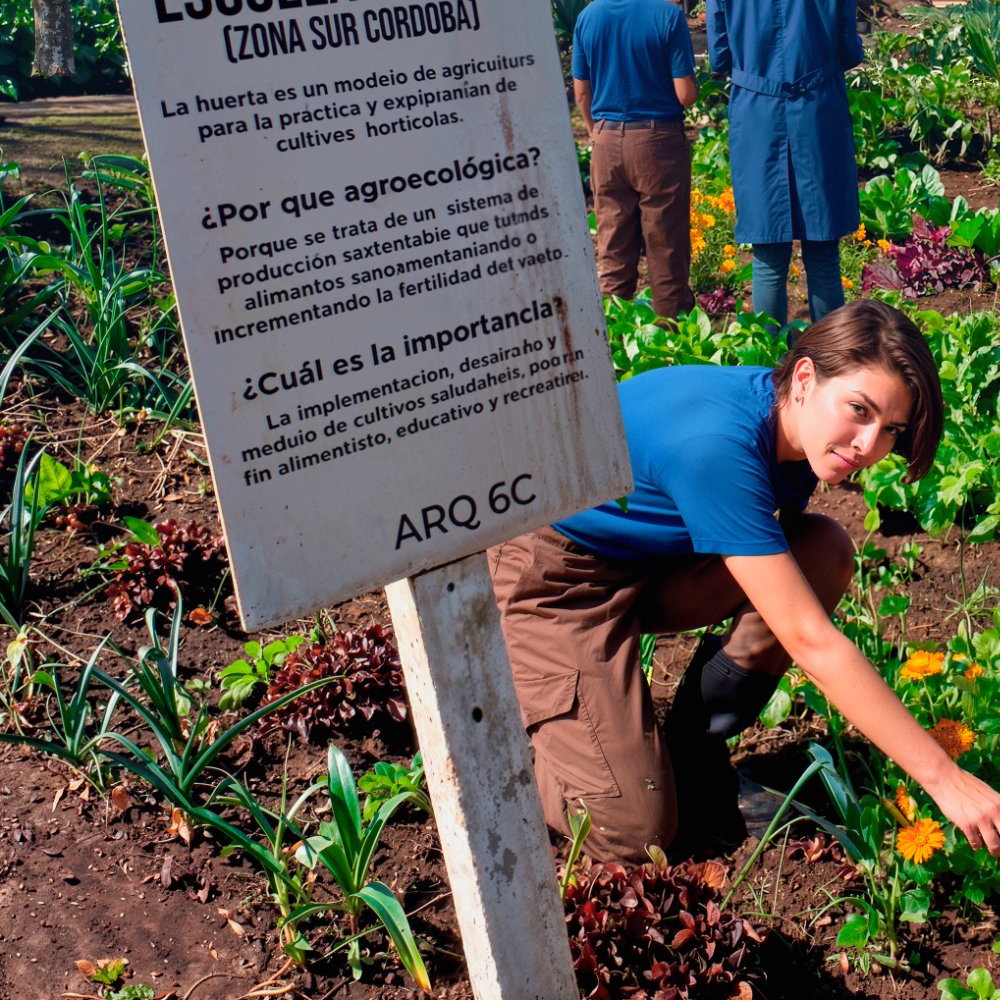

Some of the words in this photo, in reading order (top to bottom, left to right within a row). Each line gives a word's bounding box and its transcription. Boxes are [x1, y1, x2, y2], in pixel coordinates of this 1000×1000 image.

[222, 18, 307, 64] (ZONA
[308, 12, 360, 50] SUR
[160, 100, 190, 118] La
[195, 89, 268, 112] huerta
[274, 86, 297, 101] es
[303, 82, 329, 98] un
[413, 65, 437, 82] de
[197, 119, 248, 143] para
[254, 113, 273, 130] la
[366, 100, 378, 116] y
[495, 77, 518, 93] de
[276, 128, 356, 153] cultives
[365, 111, 464, 138] horticolas.
[201, 200, 271, 230] ¿Por
[280, 189, 335, 218] que
[344, 147, 541, 203] agroecológica?
[217, 253, 337, 294] producción
[456, 219, 489, 238] que
[219, 237, 298, 264] Porque
[304, 231, 326, 246] se
[332, 219, 378, 240] trata
[384, 212, 408, 229] de
[413, 207, 436, 223] un
[447, 192, 513, 216] sistema
[517, 184, 539, 201] de
[244, 276, 346, 311] alimantos
[526, 232, 537, 245] o
[376, 288, 393, 304] la
[399, 264, 482, 298] fertilidad
[242, 358, 324, 400] ¿Cuál
[333, 352, 364, 375] es
[370, 343, 396, 366] la
[266, 413, 291, 430] La
[297, 367, 455, 421] implementacion,
[547, 336, 556, 350] y
[241, 429, 317, 462] meduio
[323, 420, 348, 437] de
[353, 396, 426, 428] cultivos
[243, 468, 272, 486] fin
[278, 432, 392, 476] alimentisto,
[396, 402, 484, 438] educativo
[488, 396, 499, 412] y
[395, 494, 481, 550] ARQ
[488, 473, 536, 514] 6C
